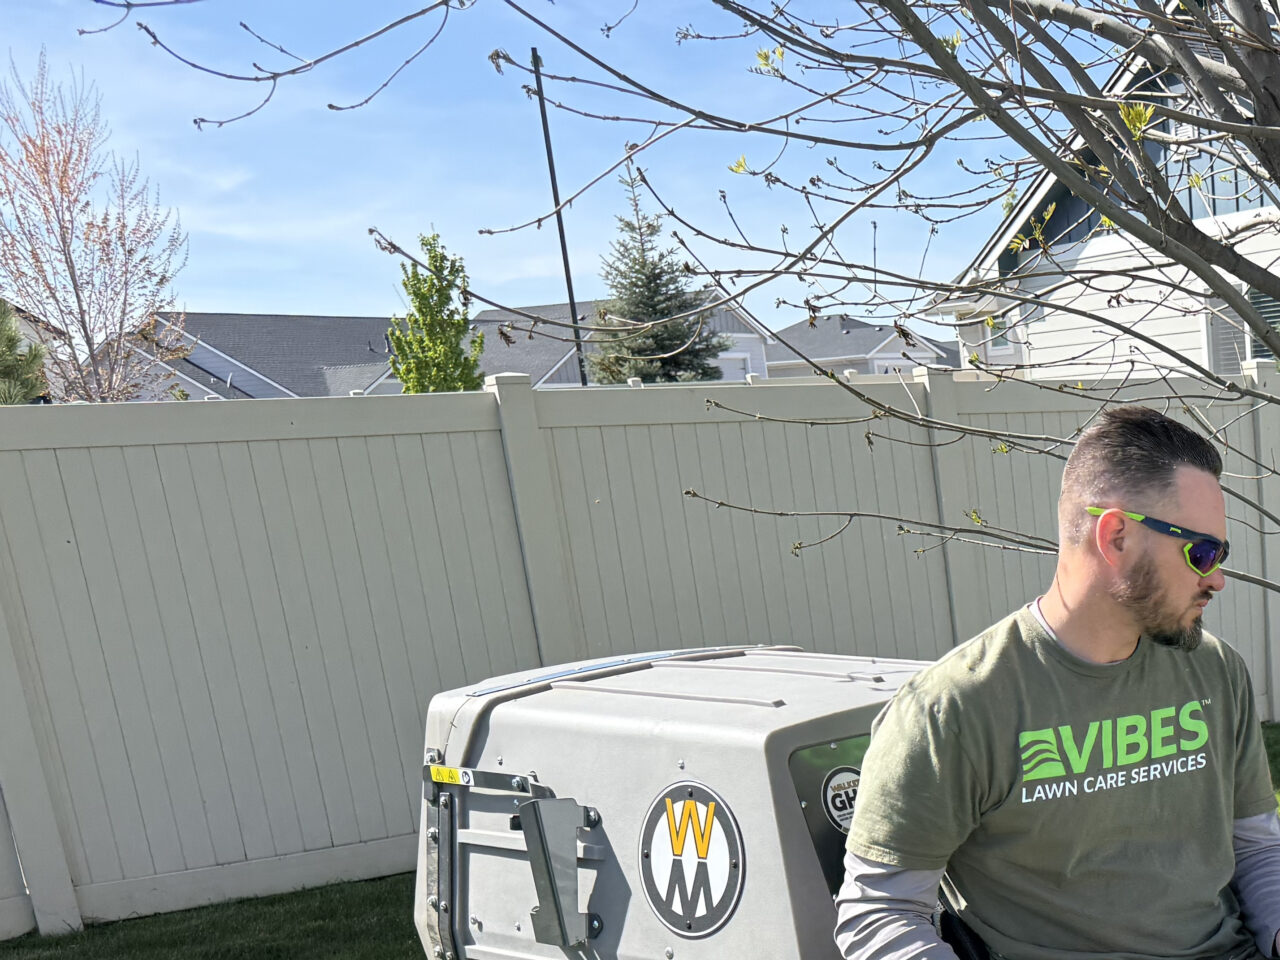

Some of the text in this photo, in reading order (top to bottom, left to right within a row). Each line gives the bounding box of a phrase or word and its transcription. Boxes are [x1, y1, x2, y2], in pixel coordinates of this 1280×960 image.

[1058, 700, 1209, 774] VIBES
[831, 788, 858, 812] GH
[1021, 753, 1207, 804] LAWN CARE SERVICES
